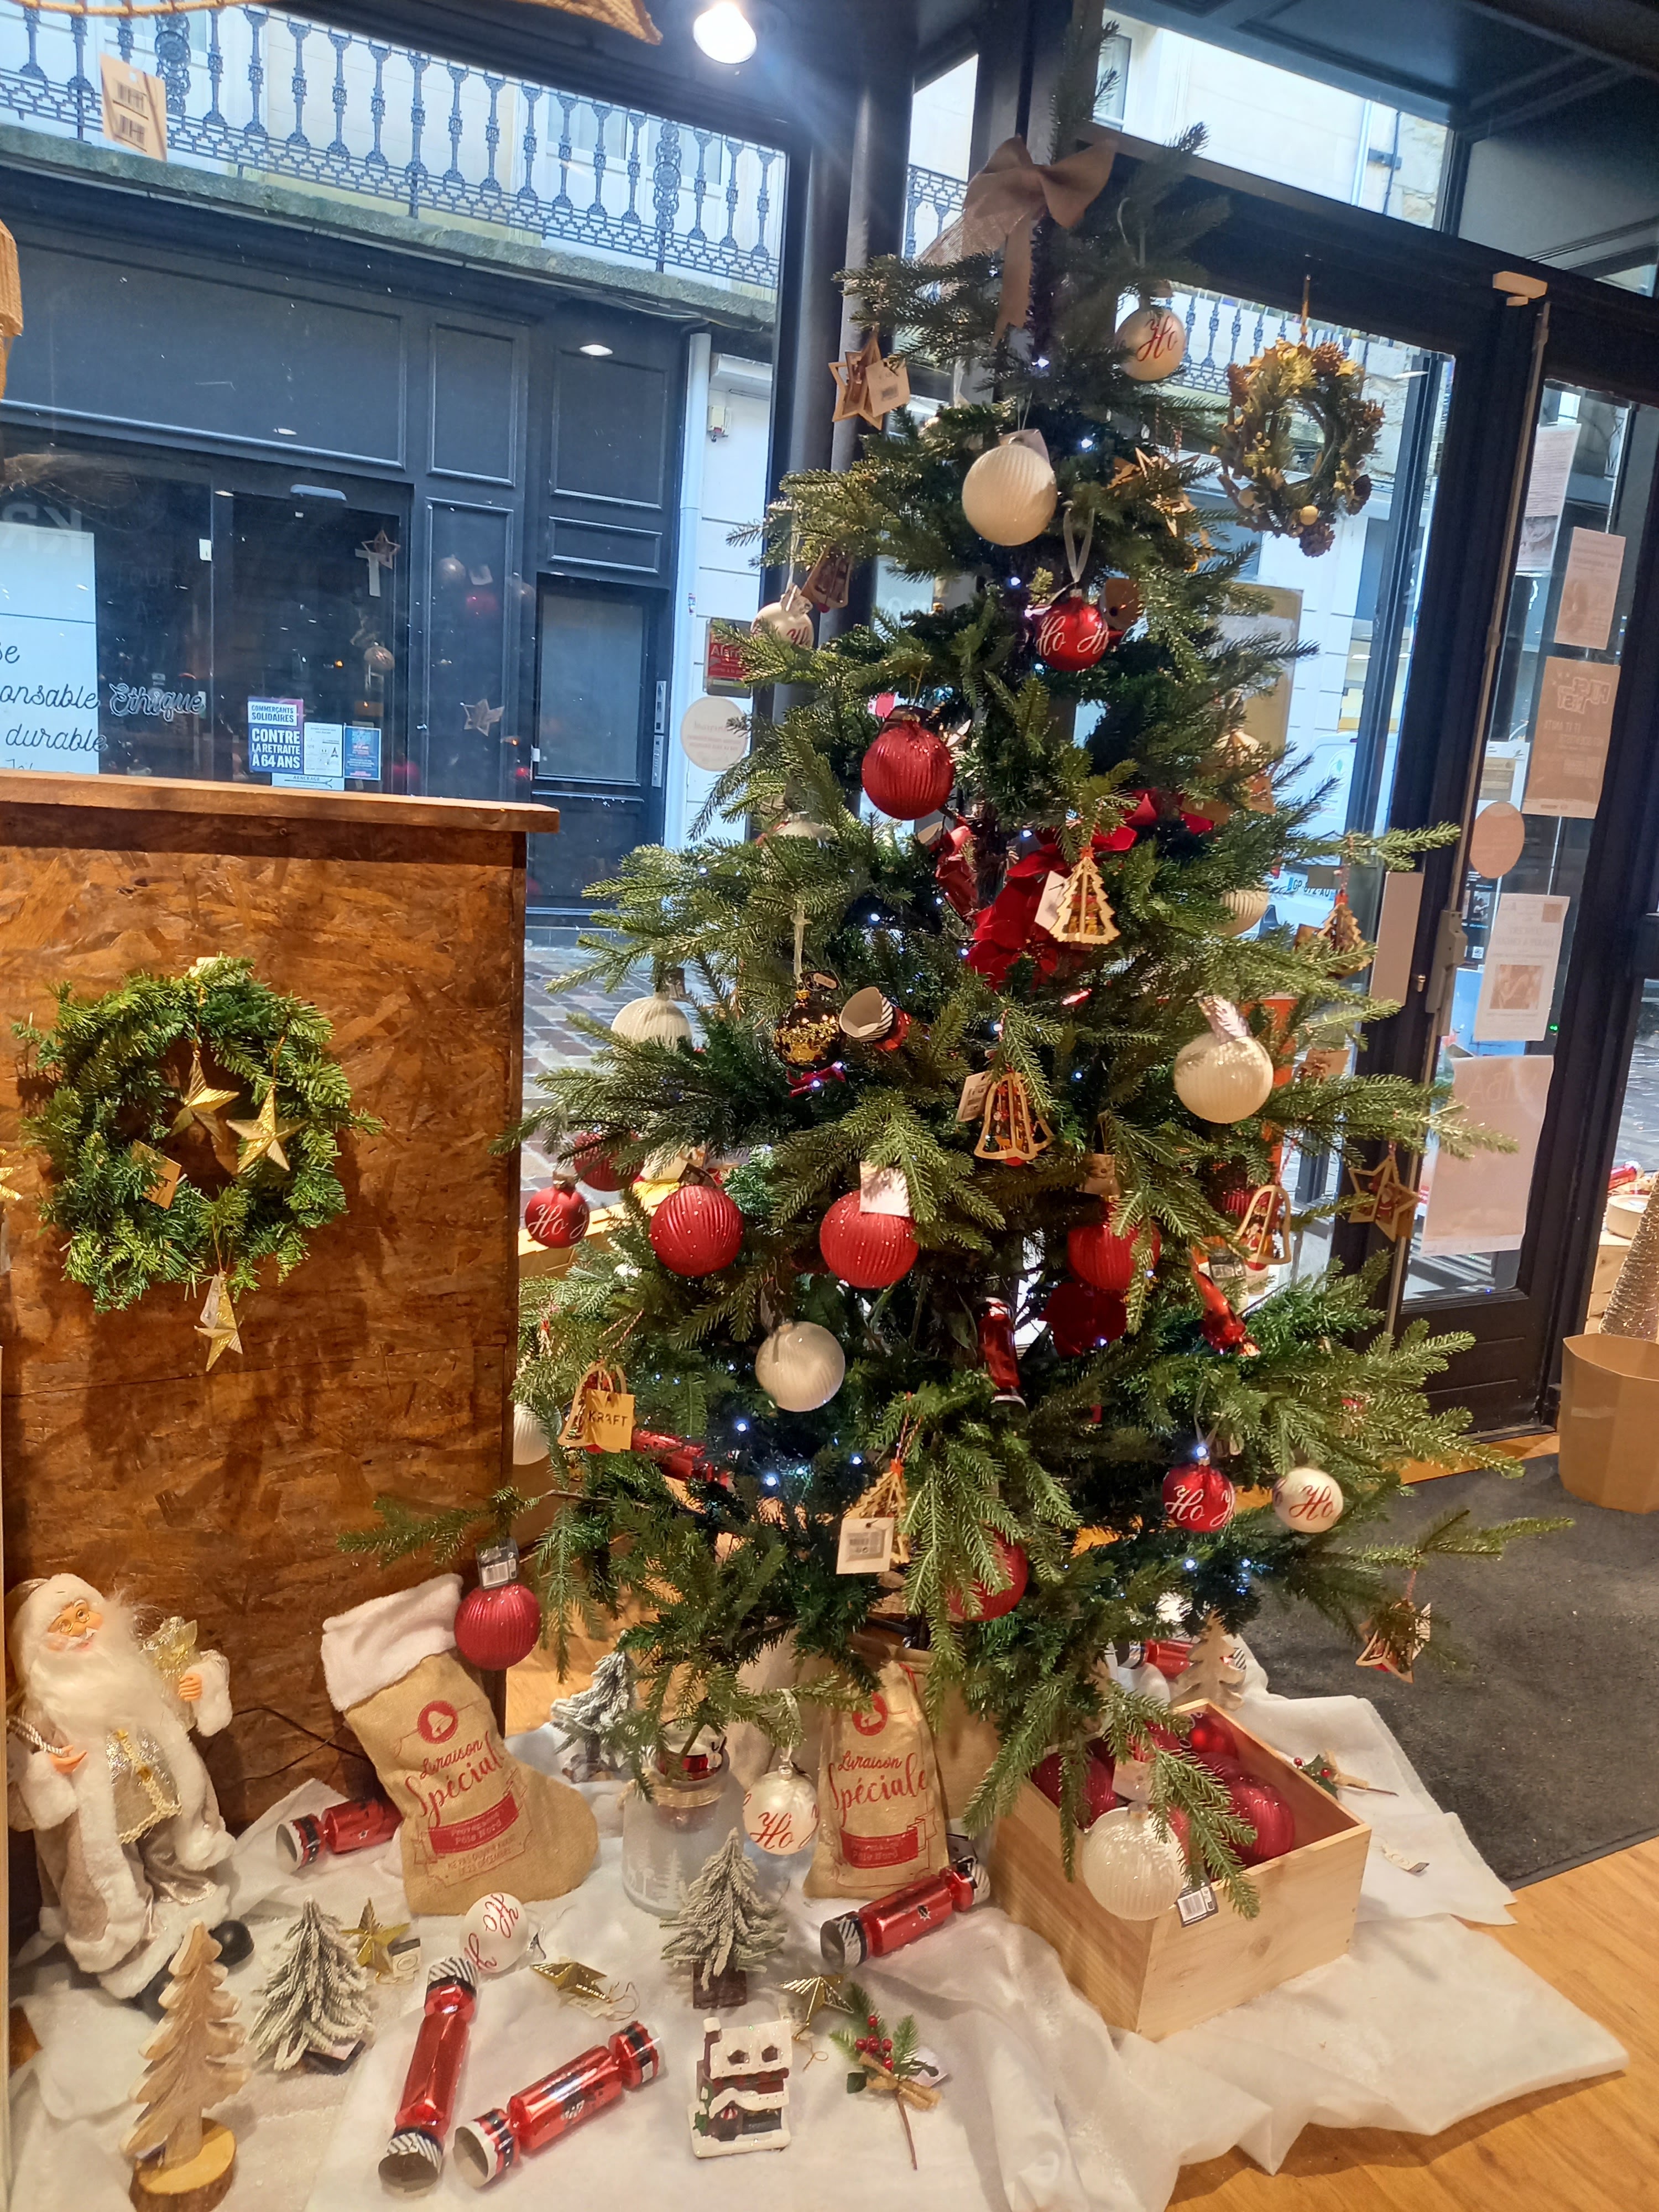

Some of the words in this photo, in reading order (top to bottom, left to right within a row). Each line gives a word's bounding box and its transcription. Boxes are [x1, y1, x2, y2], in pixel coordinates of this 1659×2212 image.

[252, 705, 294, 714] COMMERÇANTS
[252, 712, 294, 722] SOLIDAIRES
[6, 723, 108, 752] durable
[252, 728, 300, 744] CONTRE
[252, 743, 262, 753] LA
[262, 744, 300, 755] RETRAITE
[261, 754, 276, 768] 64
[277, 755, 300, 769] ANS
[528, 1203, 569, 1239] Ho
[588, 1410, 628, 1427] KRAFT
[1164, 1485, 1205, 1521] Ho
[1289, 1485, 1334, 1521] Ho
[750, 1812, 795, 1850] Ho
